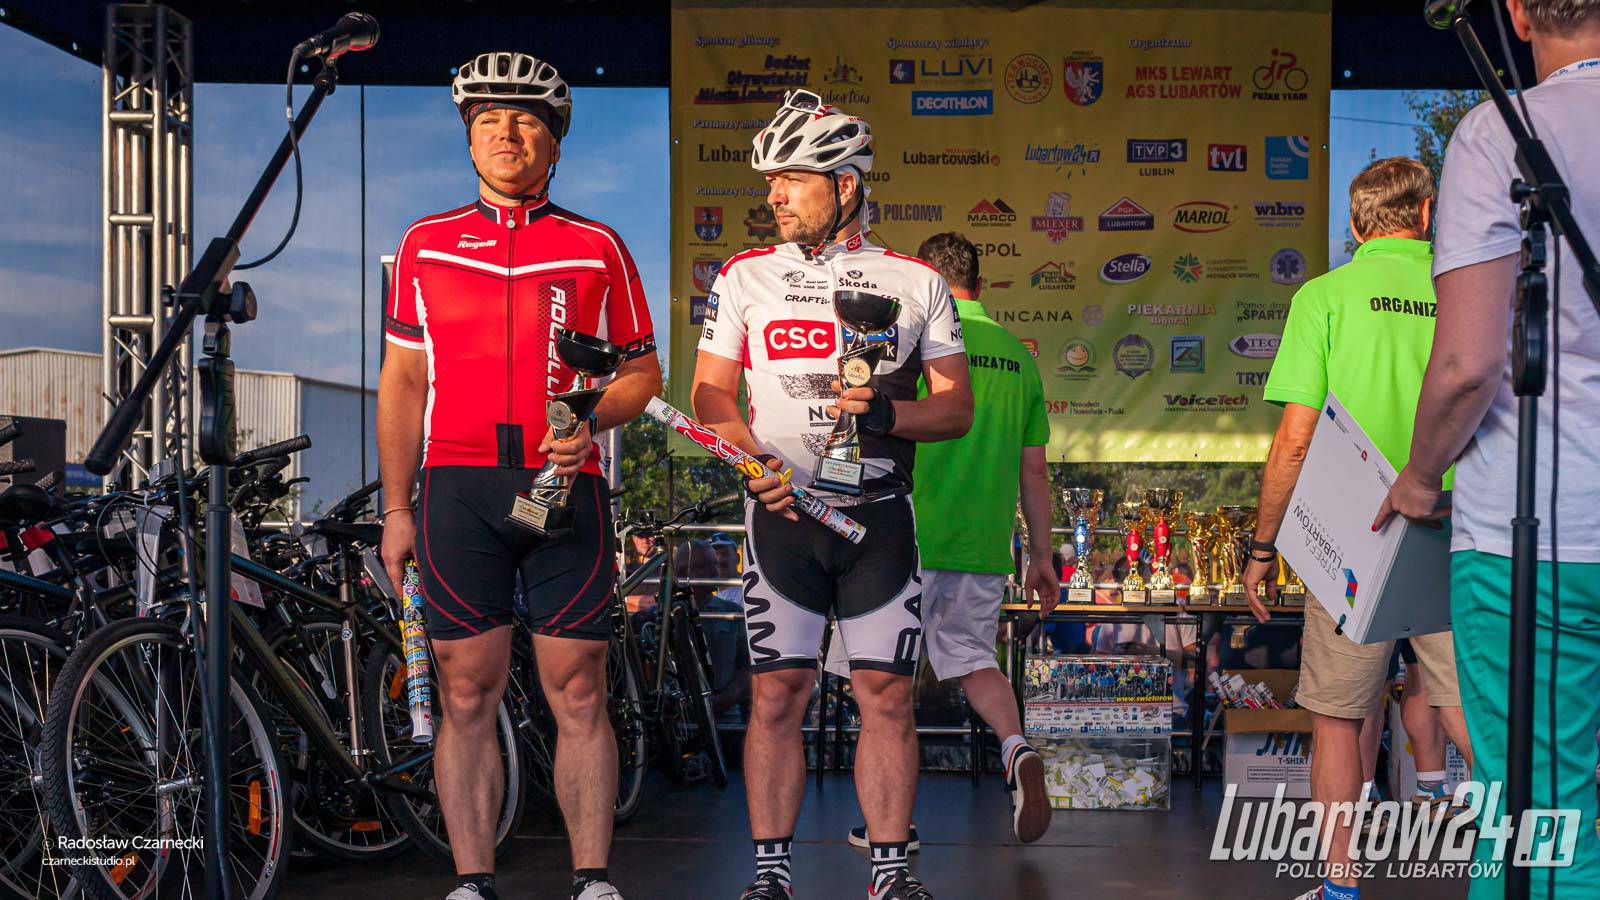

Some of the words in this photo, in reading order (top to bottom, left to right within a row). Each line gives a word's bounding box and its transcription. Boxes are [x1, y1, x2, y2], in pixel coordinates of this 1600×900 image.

[921, 58, 992, 76] LUVI
[1136, 66, 1168, 81] MKS
[1172, 66, 1233, 81] LEWART
[1126, 84, 1156, 99] AGS
[1160, 81, 1243, 99] LUBARTÓW
[916, 97, 988, 110] DECATHLON
[903, 150, 990, 165] Lubartowski
[1139, 167, 1175, 176] LUBLIN
[1035, 218, 1078, 228] MLEXER
[1174, 209, 1230, 225] MARIOL
[456, 239, 497, 250] Rogelli
[846, 239, 862, 250] CSC
[1109, 259, 1145, 274] Stella
[839, 276, 878, 289] Škoda
[785, 294, 821, 303] CRAFT
[995, 309, 1073, 322] INCANA
[1127, 303, 1216, 317] PIEKARNIA
[768, 327, 829, 350] CSC
[1248, 338, 1282, 349] TEC
[1294, 505, 1342, 569] LUBARTÓW
[1278, 757, 1309, 765] T-SHIRT
